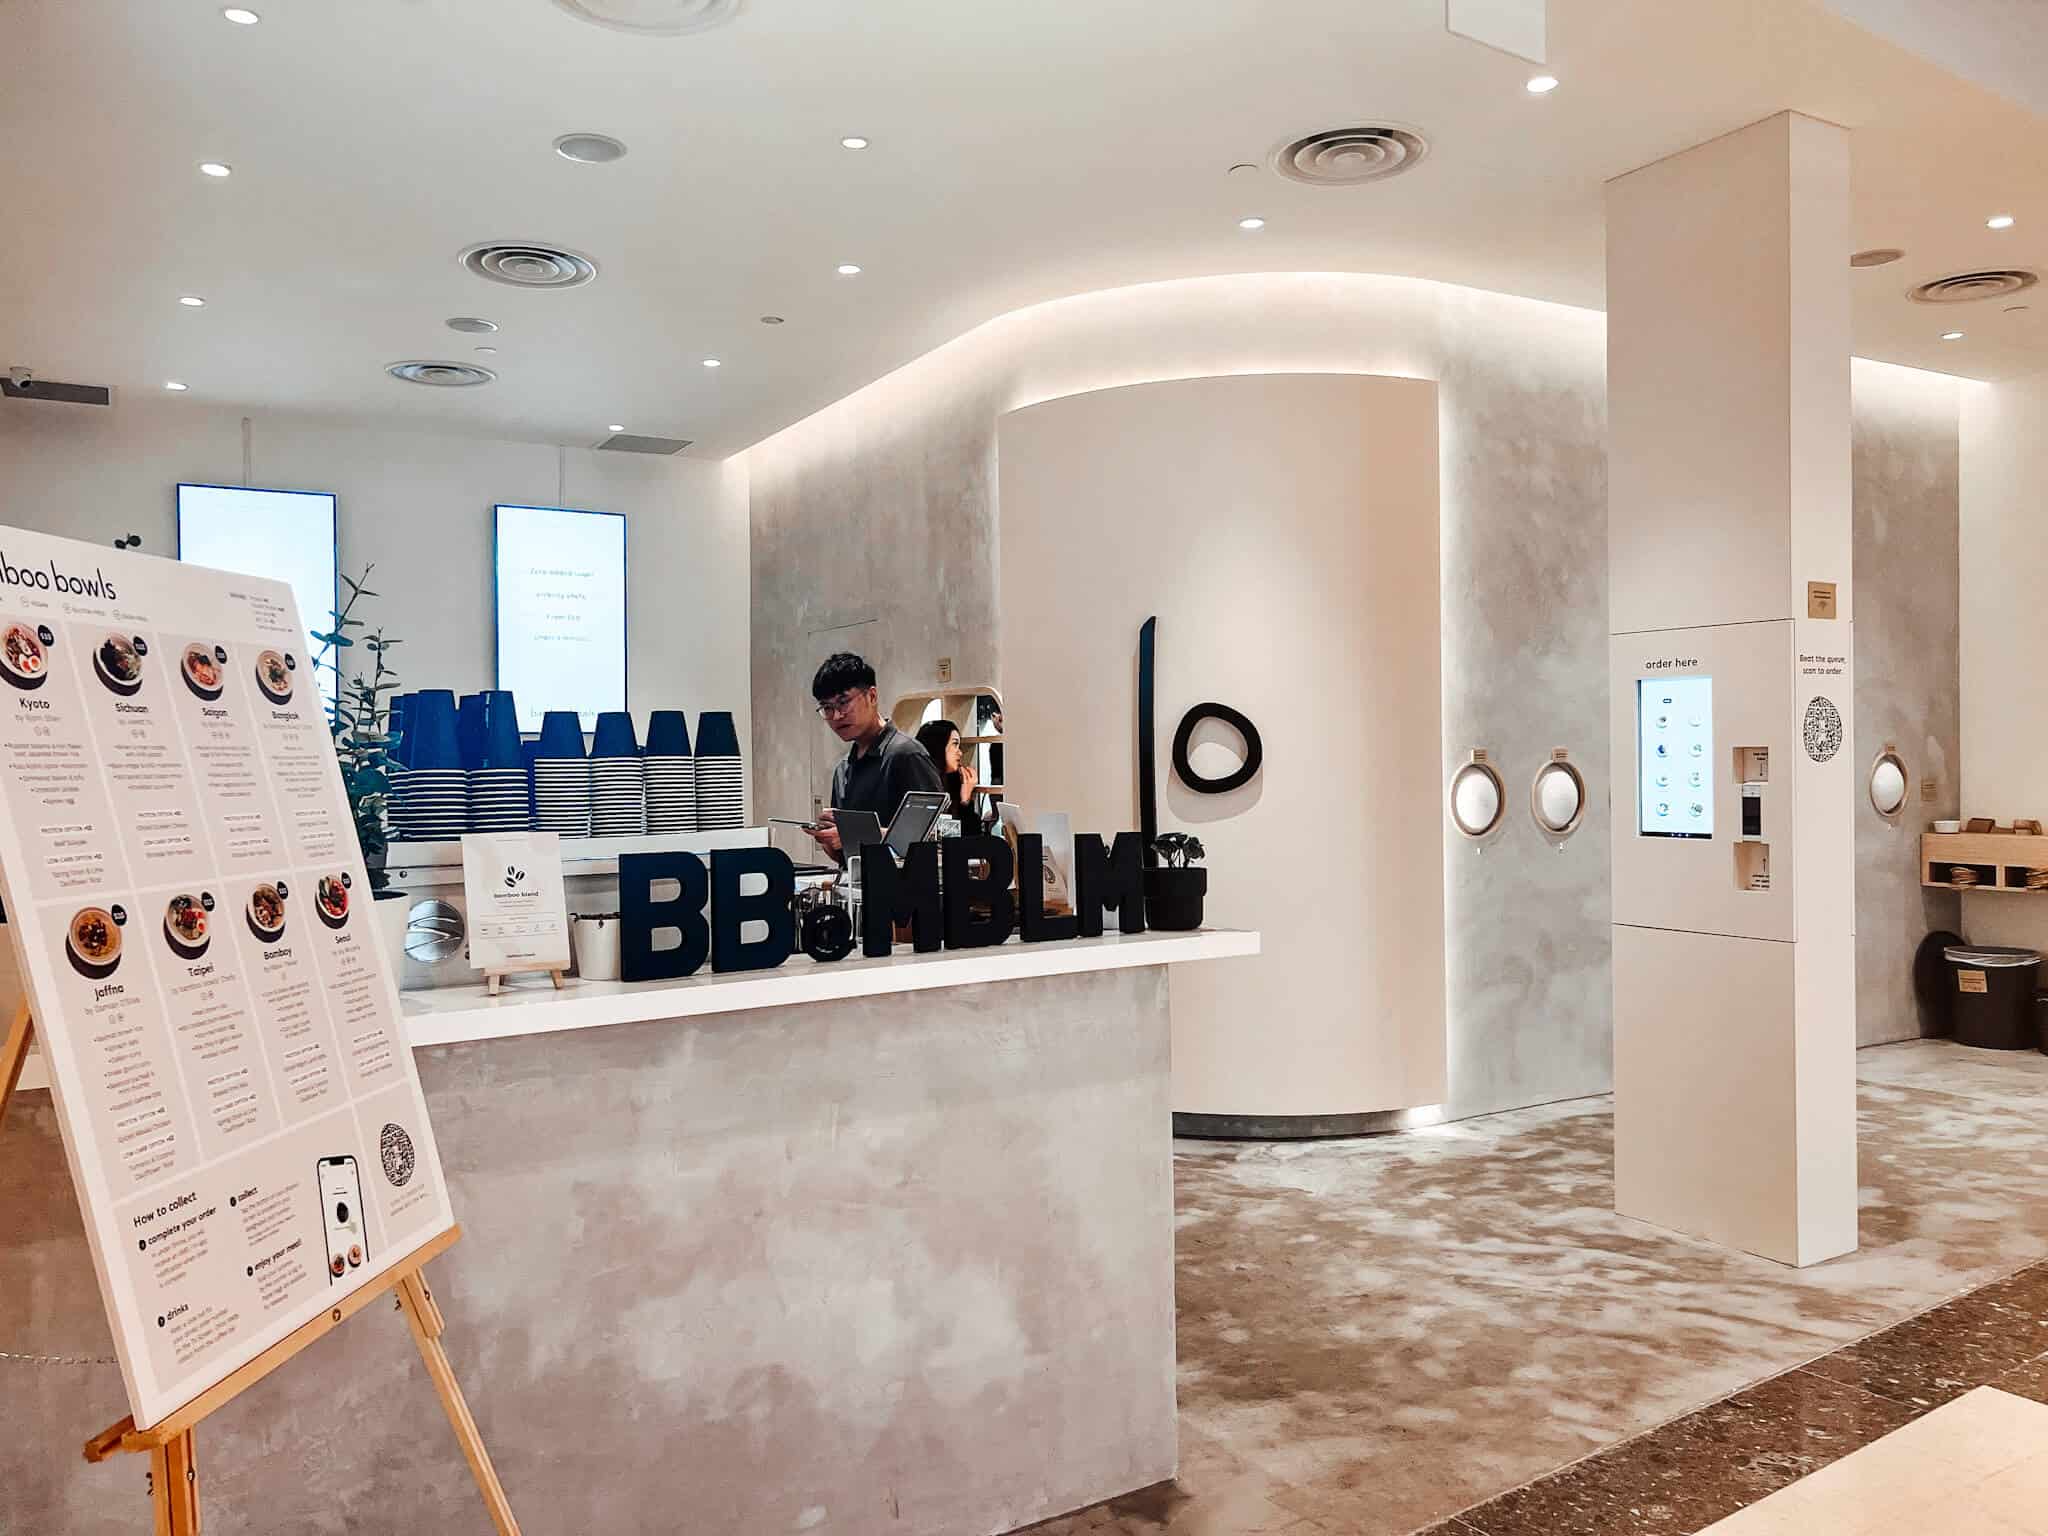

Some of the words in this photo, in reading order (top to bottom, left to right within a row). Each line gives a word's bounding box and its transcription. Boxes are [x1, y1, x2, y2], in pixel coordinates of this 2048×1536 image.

[0, 551, 50, 590] boo
[50, 559, 117, 600] bowls
[1645, 659, 1672, 669] order
[1675, 657, 1698, 668] here
[1815, 655, 1826, 663] the
[1818, 667, 1825, 675] to
[19, 698, 50, 712] Kyoto
[115, 702, 149, 713] Sichuan
[187, 963, 214, 976] Taipei
[95, 984, 124, 1001] Jaffna
[133, 1211, 154, 1228] How
[156, 1206, 167, 1217] to
[168, 1191, 197, 1212] collect
[148, 1224, 181, 1245] complete
[181, 1215, 197, 1232] your
[198, 1206, 217, 1221] order
[167, 1303, 189, 1321] drinks
